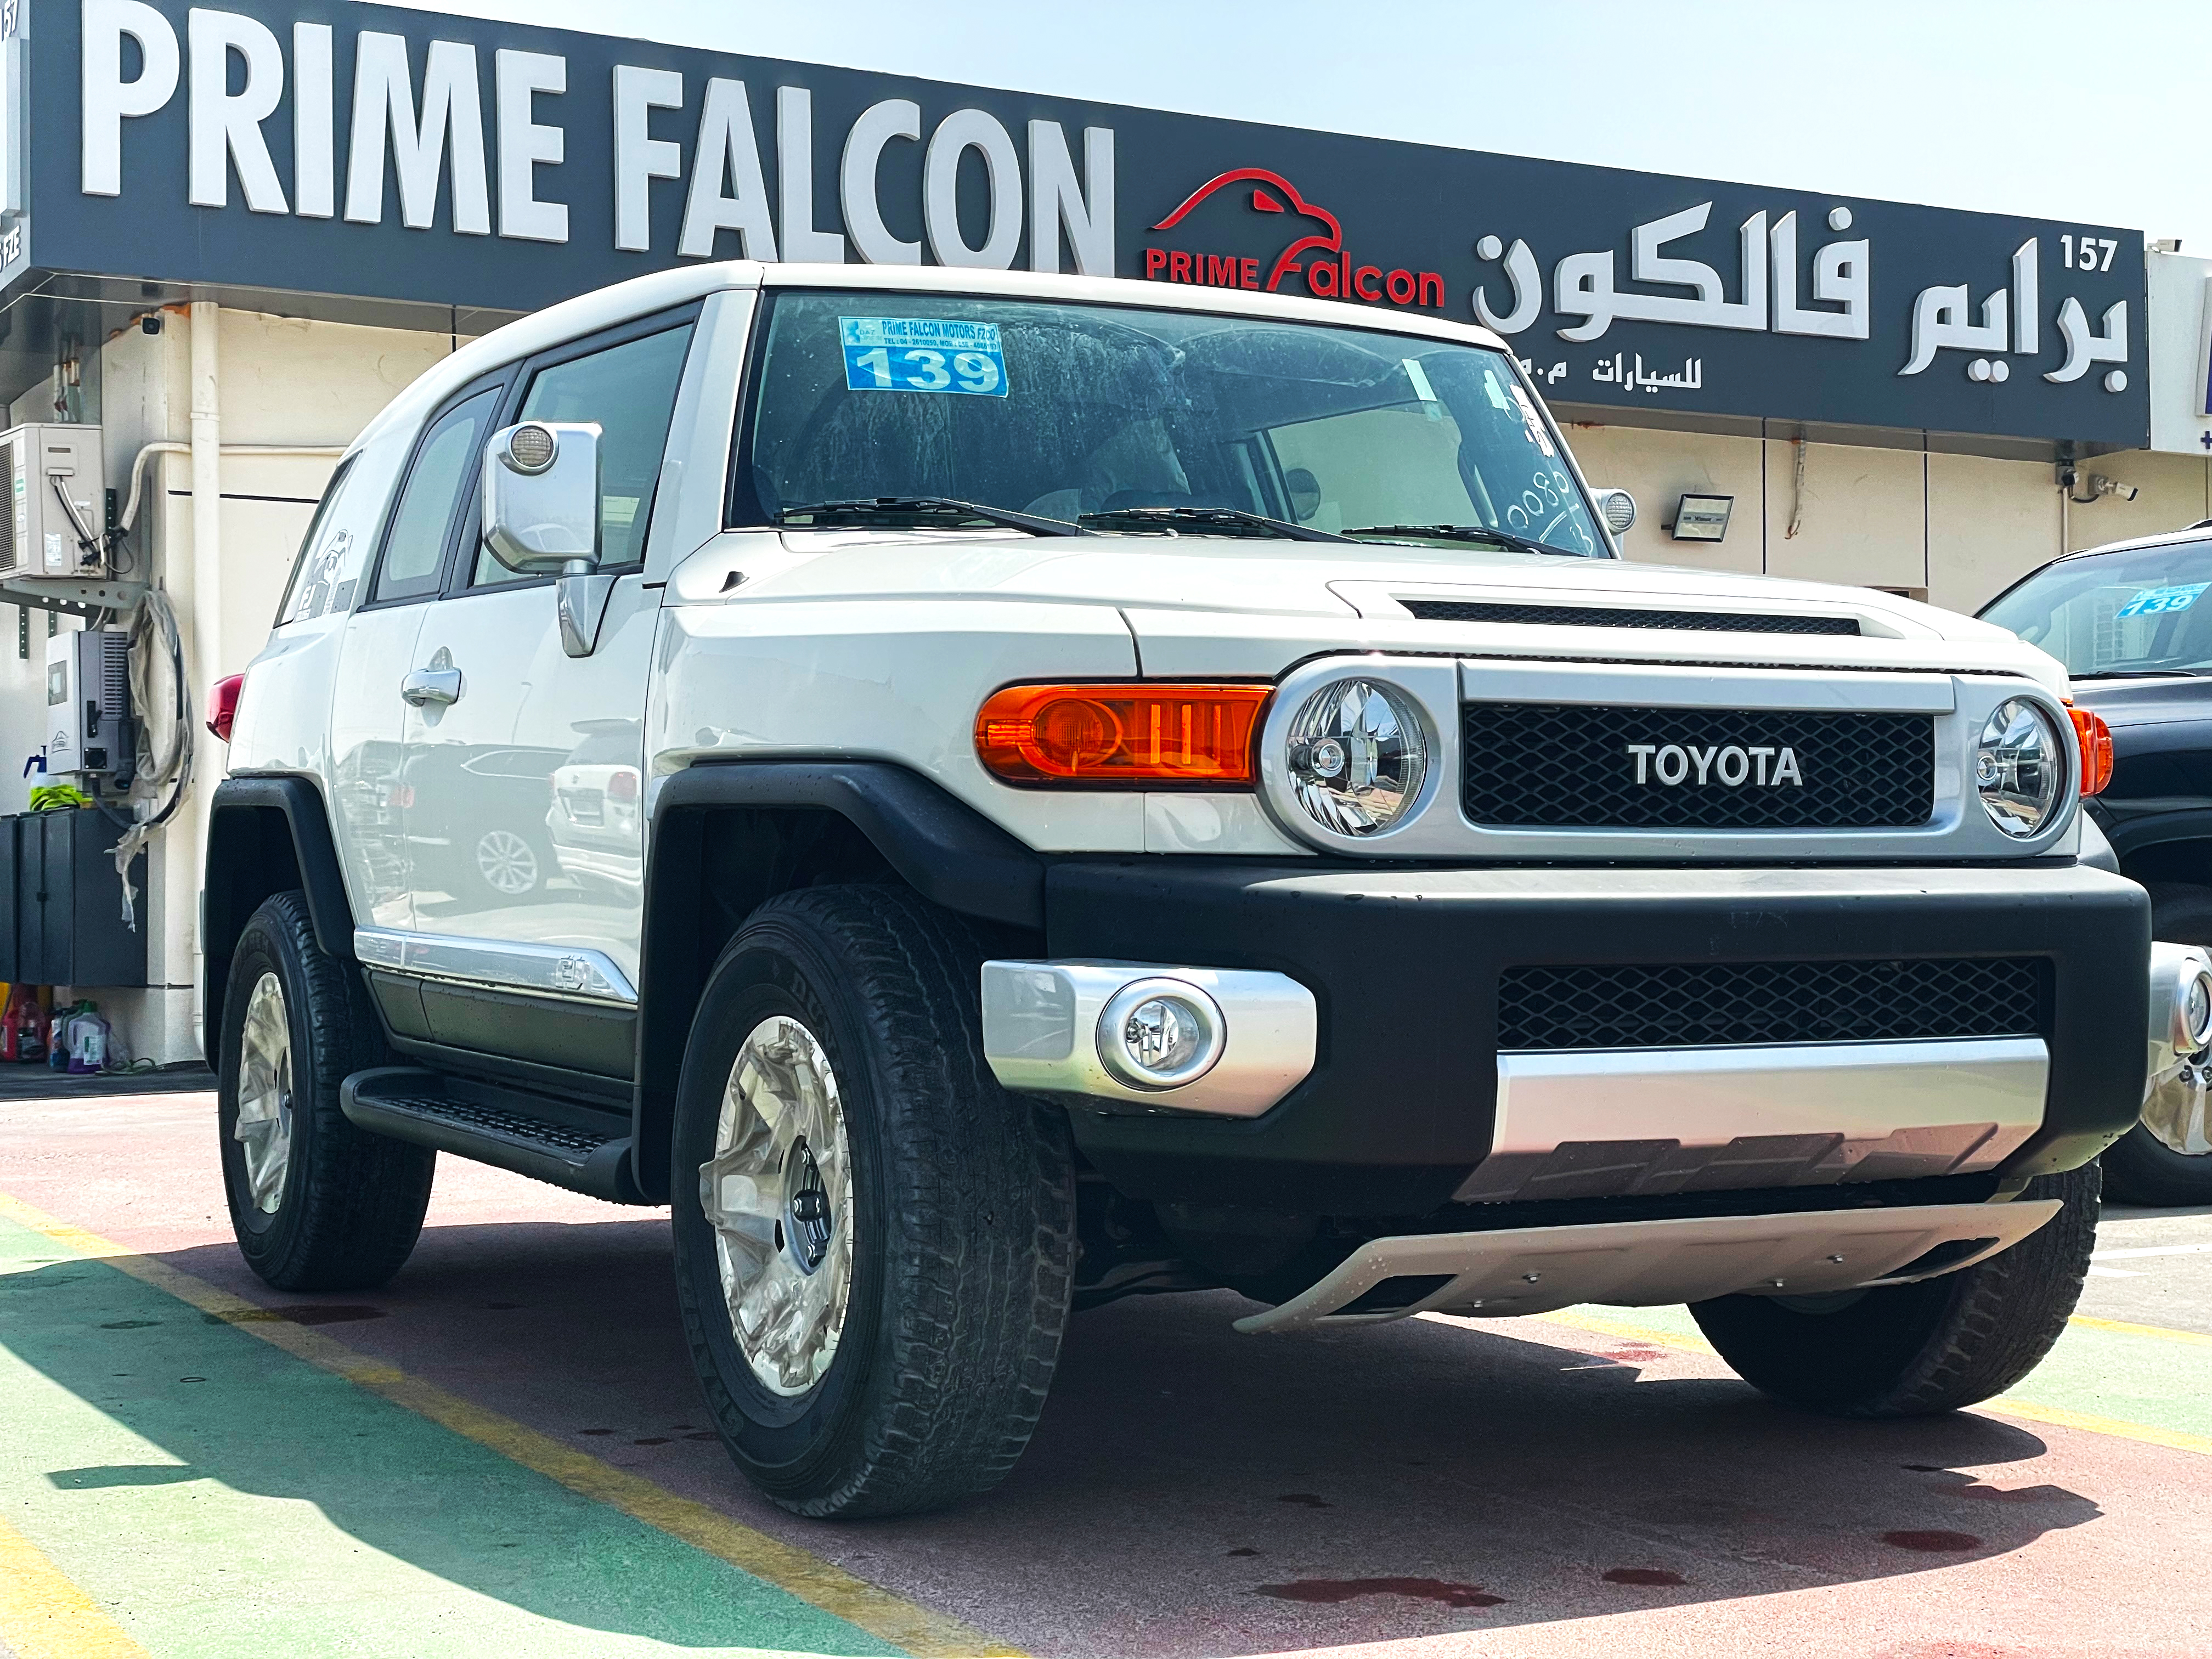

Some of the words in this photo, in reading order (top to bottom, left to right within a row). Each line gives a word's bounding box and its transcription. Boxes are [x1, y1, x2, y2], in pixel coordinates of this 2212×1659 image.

[82, 0, 569, 244] PRIME
[613, 64, 1115, 279] FALCON
[1147, 248, 1260, 290] PRIME
[1267, 236, 1444, 307] Falcon
[1472, 201, 1869, 342] فالكون
[2060, 234, 2118, 272] 157
[882, 321, 908, 335] PRIME
[909, 321, 941, 337] FALCON
[942, 323, 975, 339] MOTORS
[977, 328, 995, 340] FZCO
[1897, 236, 2128, 393] برايم
[857, 348, 999, 392] 139
[1592, 352, 1702, 393] للسيارات
[2126, 595, 2193, 616] 139
[1628, 744, 1803, 787] TOYOTA
